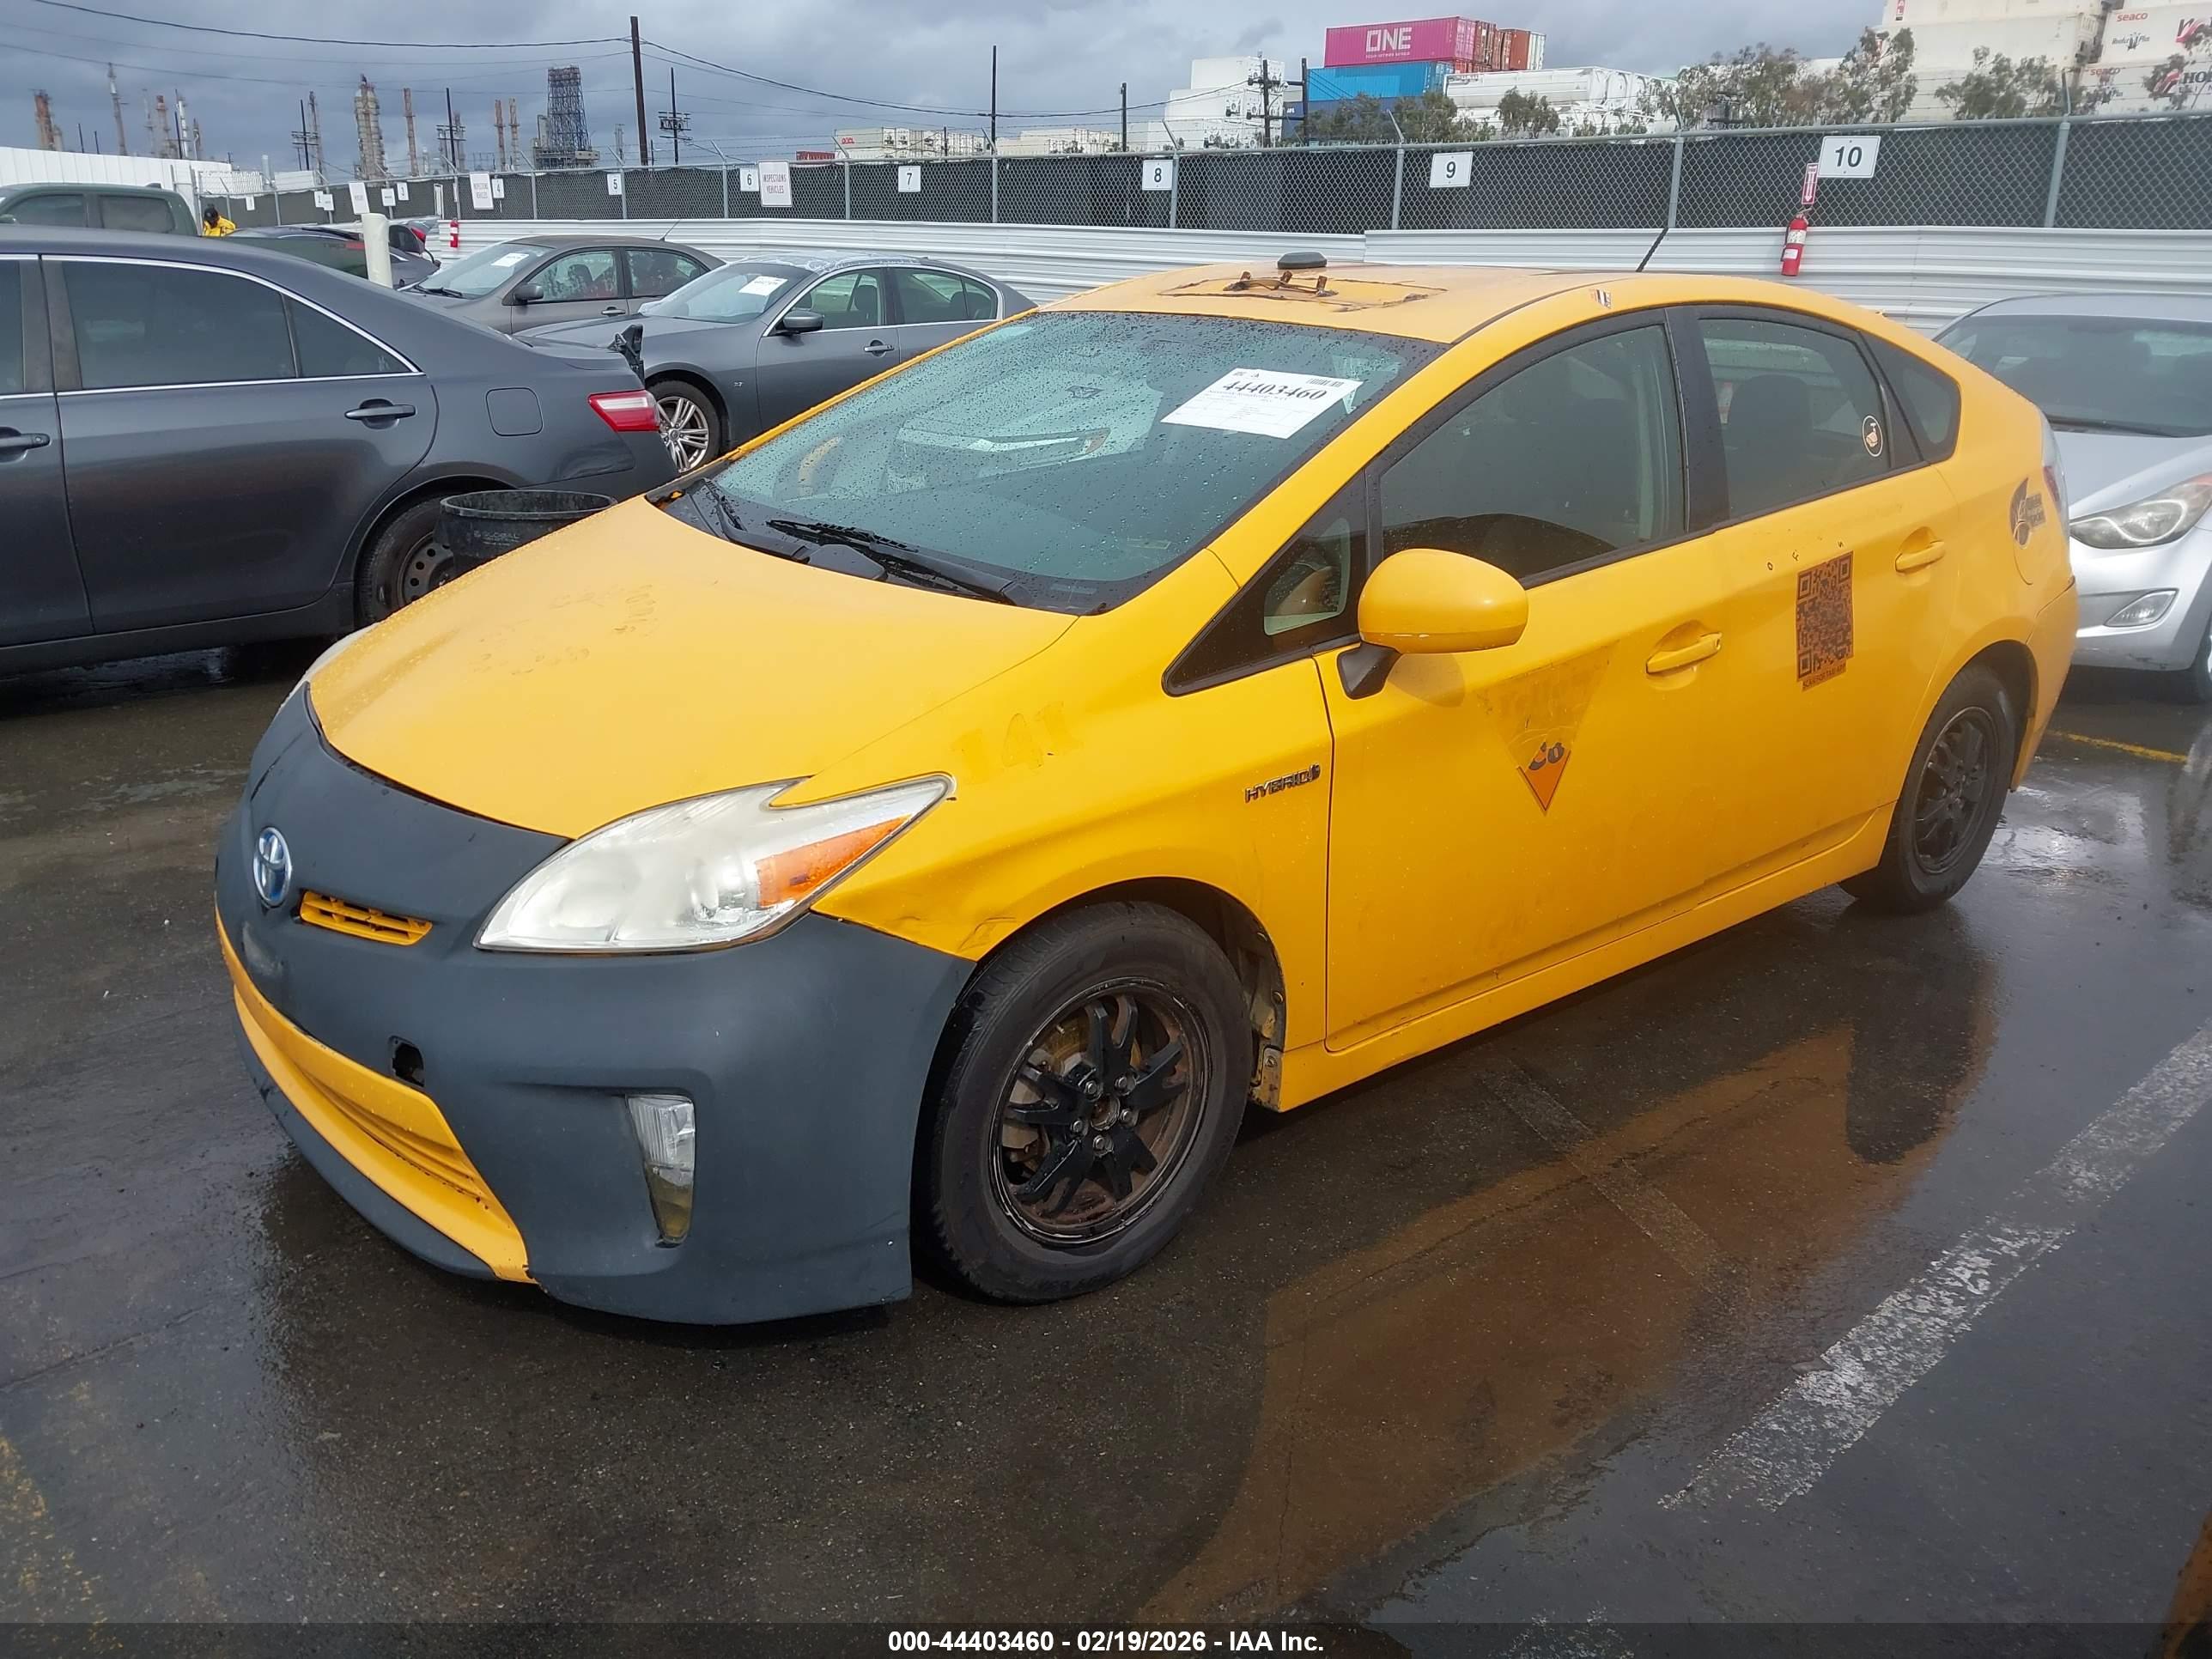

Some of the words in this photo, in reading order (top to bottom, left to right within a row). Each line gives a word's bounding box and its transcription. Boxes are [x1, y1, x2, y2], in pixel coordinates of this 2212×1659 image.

[2116, 12, 2148, 22] seaco
[1365, 27, 1413, 52] ONE
[1834, 145, 1863, 167] 10
[1153, 167, 1162, 183] 8
[1446, 161, 1456, 179] 9
[612, 179, 618, 190] 5
[746, 173, 752, 185] 6
[762, 173, 787, 183] INSPECTIONS
[906, 173, 913, 186] 7
[766, 185, 785, 194] VEHICLES
[1223, 380, 1328, 400] 44403460
[1244, 769, 1311, 804] HYBRID
